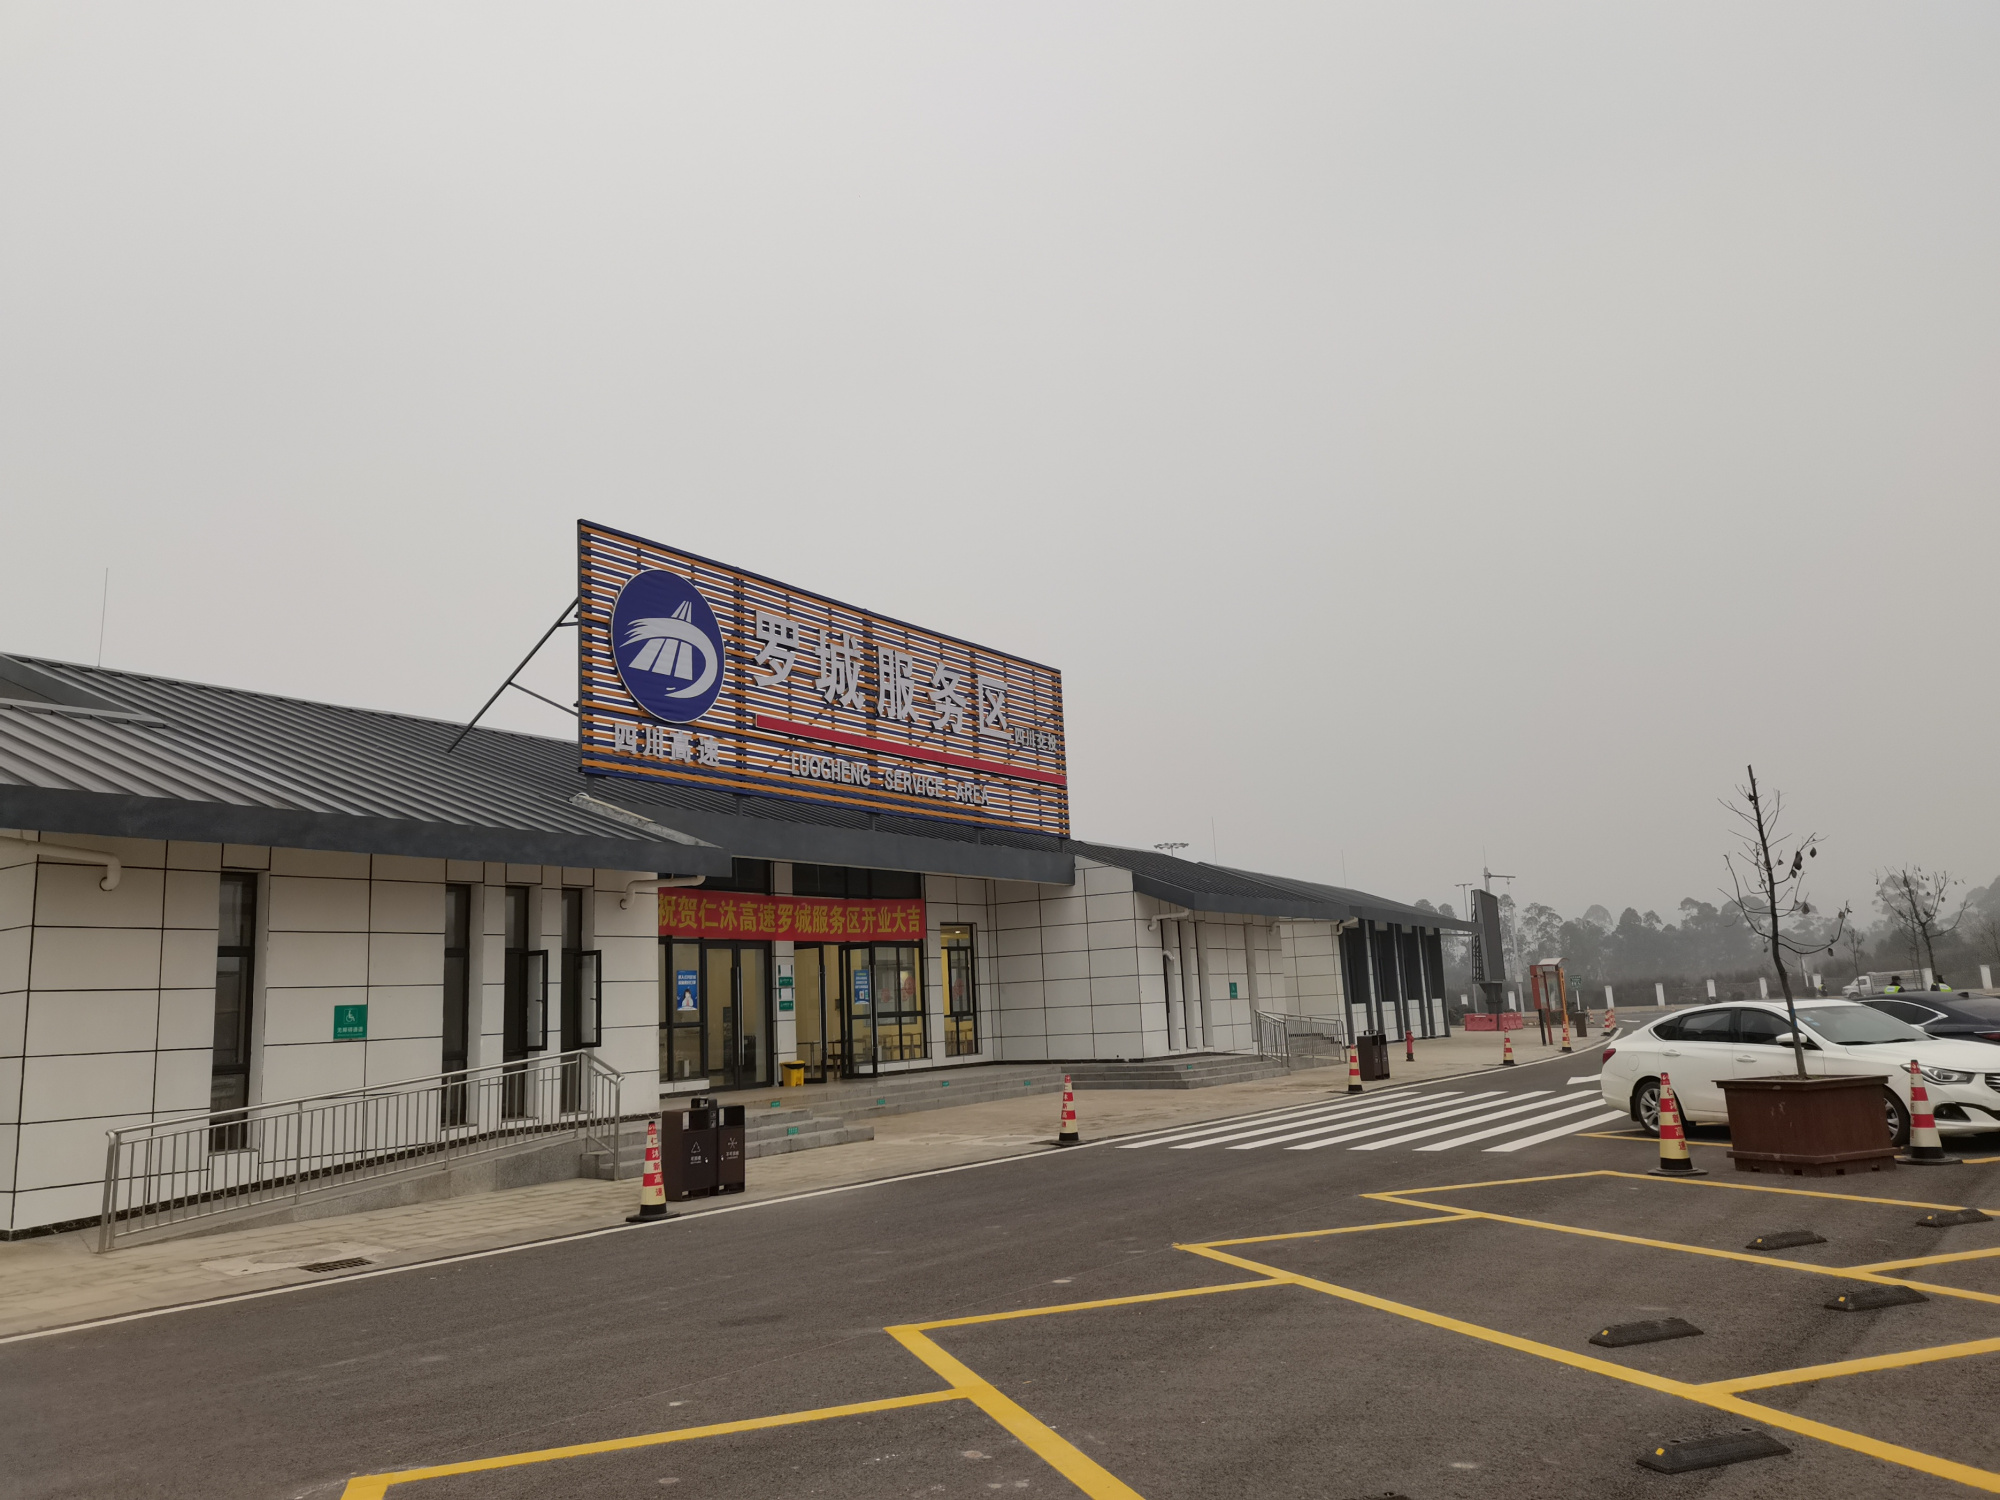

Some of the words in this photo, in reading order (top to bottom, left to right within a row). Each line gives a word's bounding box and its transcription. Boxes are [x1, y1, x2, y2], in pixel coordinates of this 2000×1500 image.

[753, 610, 1012, 741] 罗城服务区
[614, 722, 720, 767] 四川高速
[1014, 727, 1057, 752] 四川交投
[884, 769, 944, 798] SERVICE
[955, 781, 990, 806] AREA
[658, 892, 921, 935] 祝贺仁沐高速罗城服务区开业大吉
